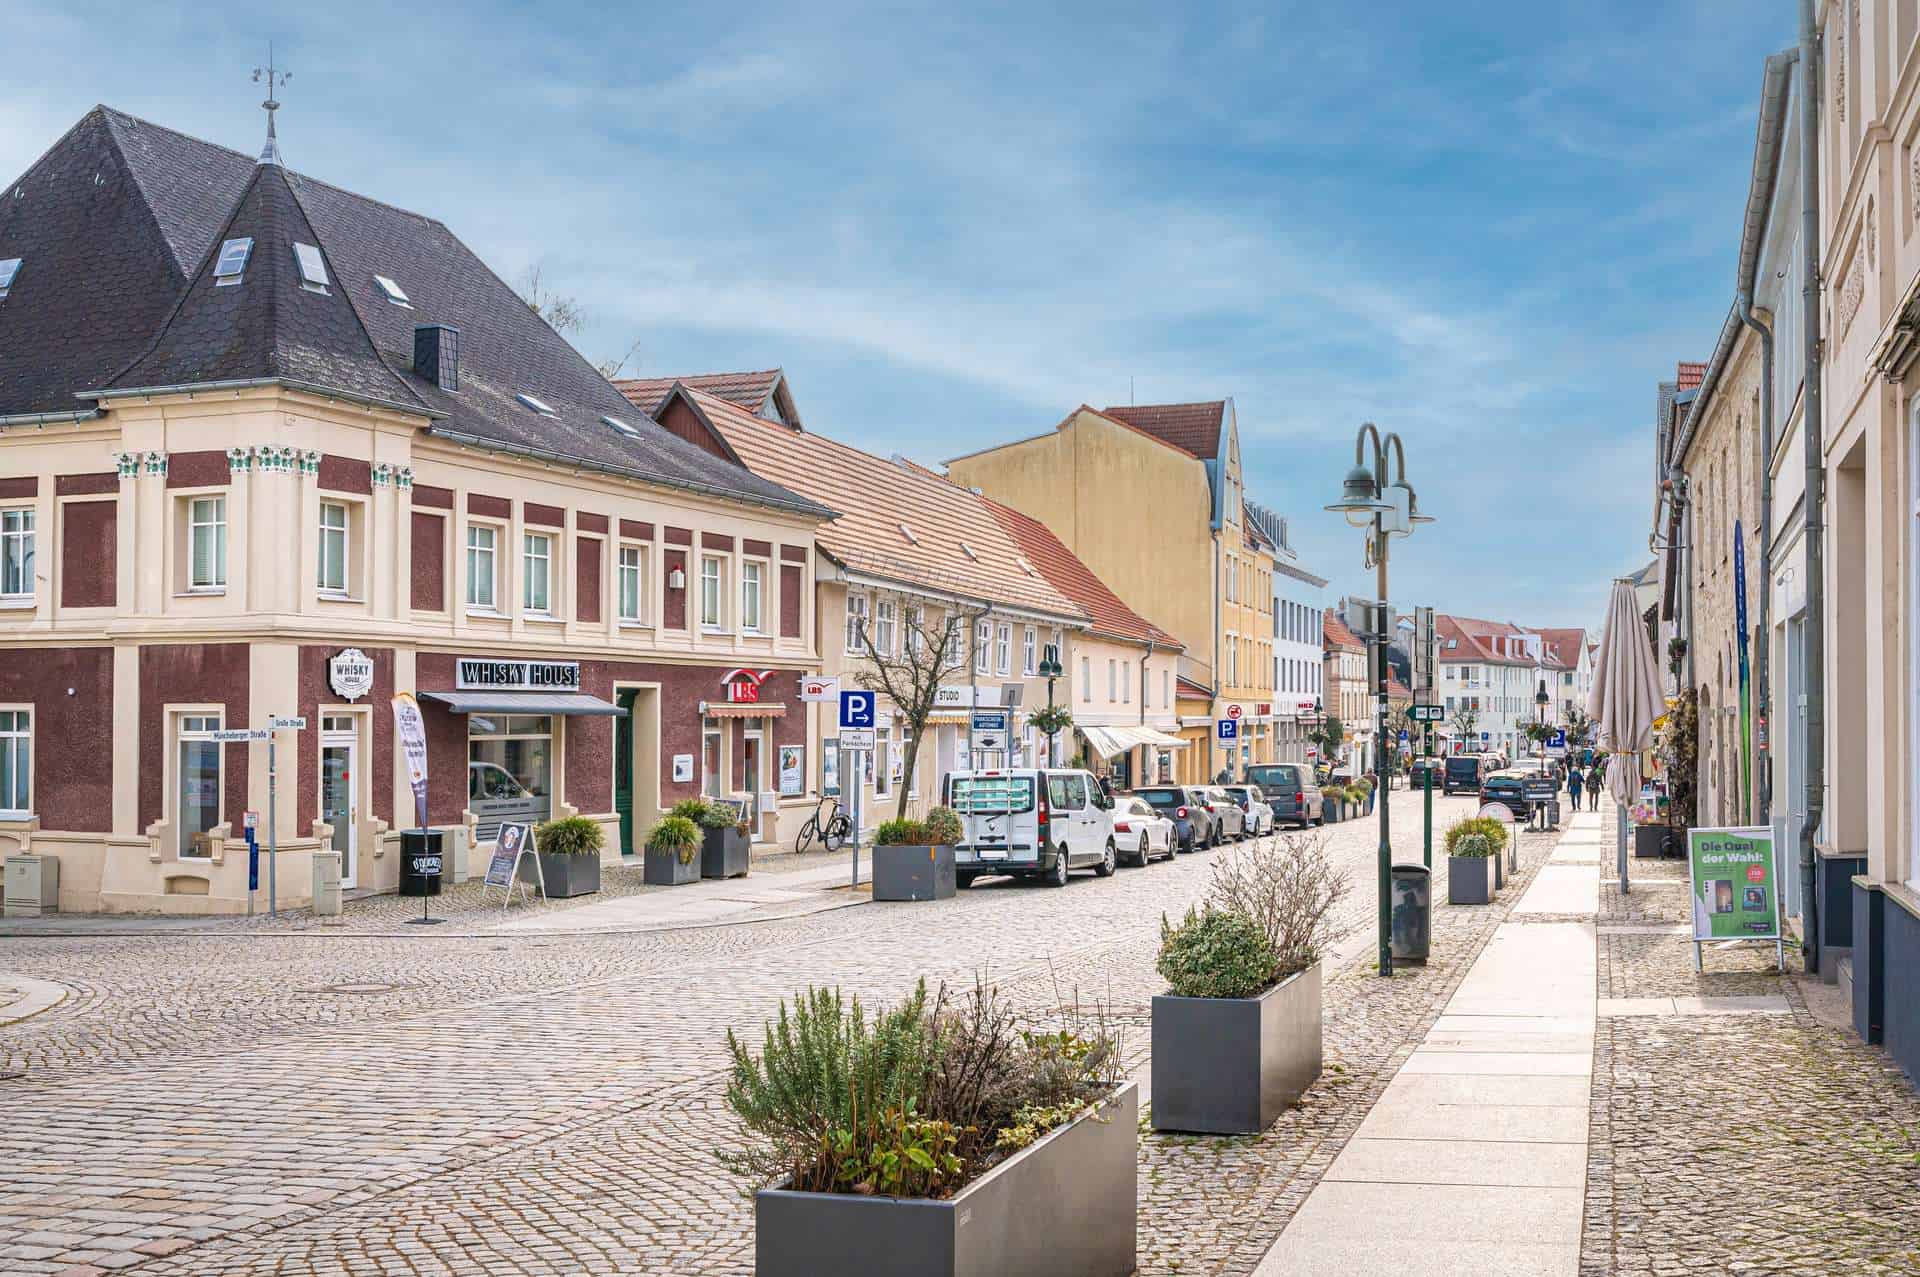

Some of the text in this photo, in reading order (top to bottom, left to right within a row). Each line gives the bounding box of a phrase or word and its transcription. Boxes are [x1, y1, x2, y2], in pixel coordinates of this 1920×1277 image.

[336, 664, 369, 675] WHISKY
[464, 663, 580, 685] WHISKY HOUSE
[731, 682, 759, 702] LBS
[939, 691, 960, 701] STUDIO
[847, 695, 867, 723] P
[1222, 722, 1233, 736] P
[1701, 842, 1721, 851] Die
[1727, 853, 1764, 862] Wahl:
